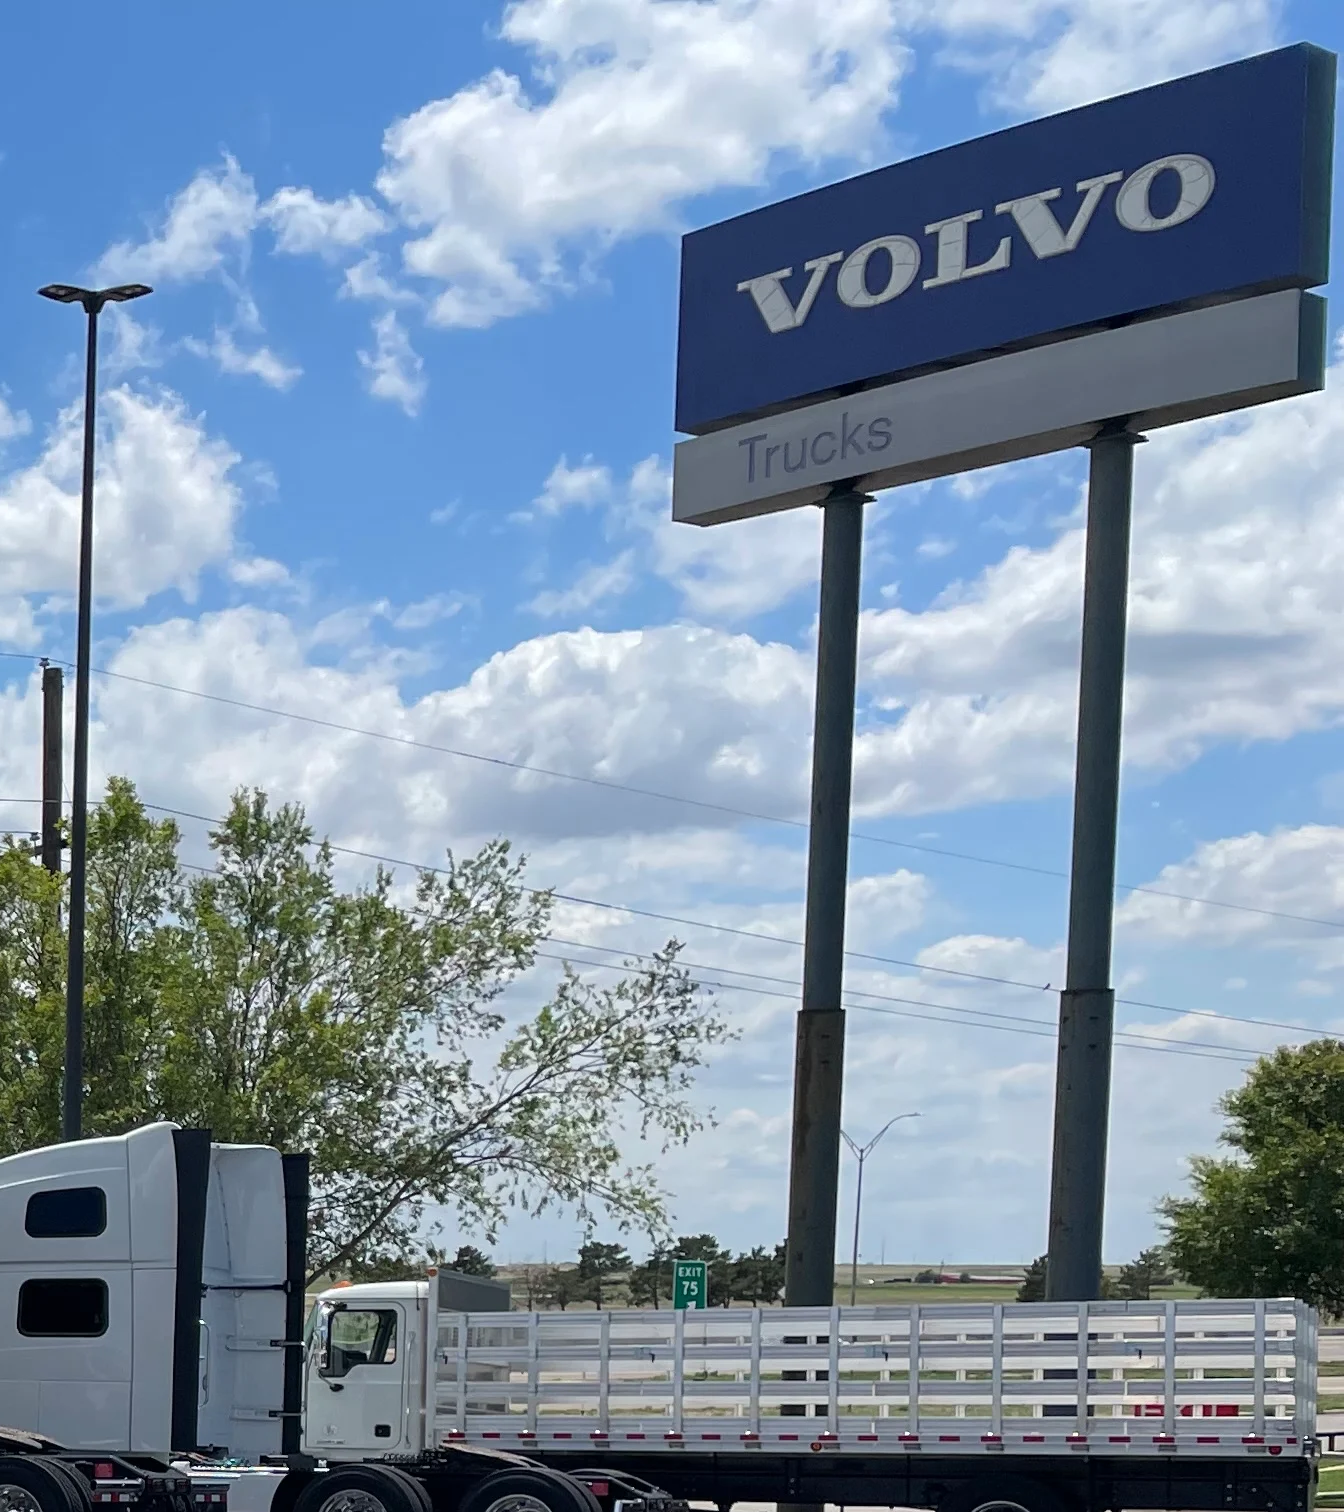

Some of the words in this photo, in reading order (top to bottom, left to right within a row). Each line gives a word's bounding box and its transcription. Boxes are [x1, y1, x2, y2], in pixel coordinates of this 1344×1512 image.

[737, 153, 1216, 333] VOLVO
[738, 411, 893, 484] Trucks
[678, 1266, 703, 1277] EXIT
[682, 1280, 699, 1296] 75
